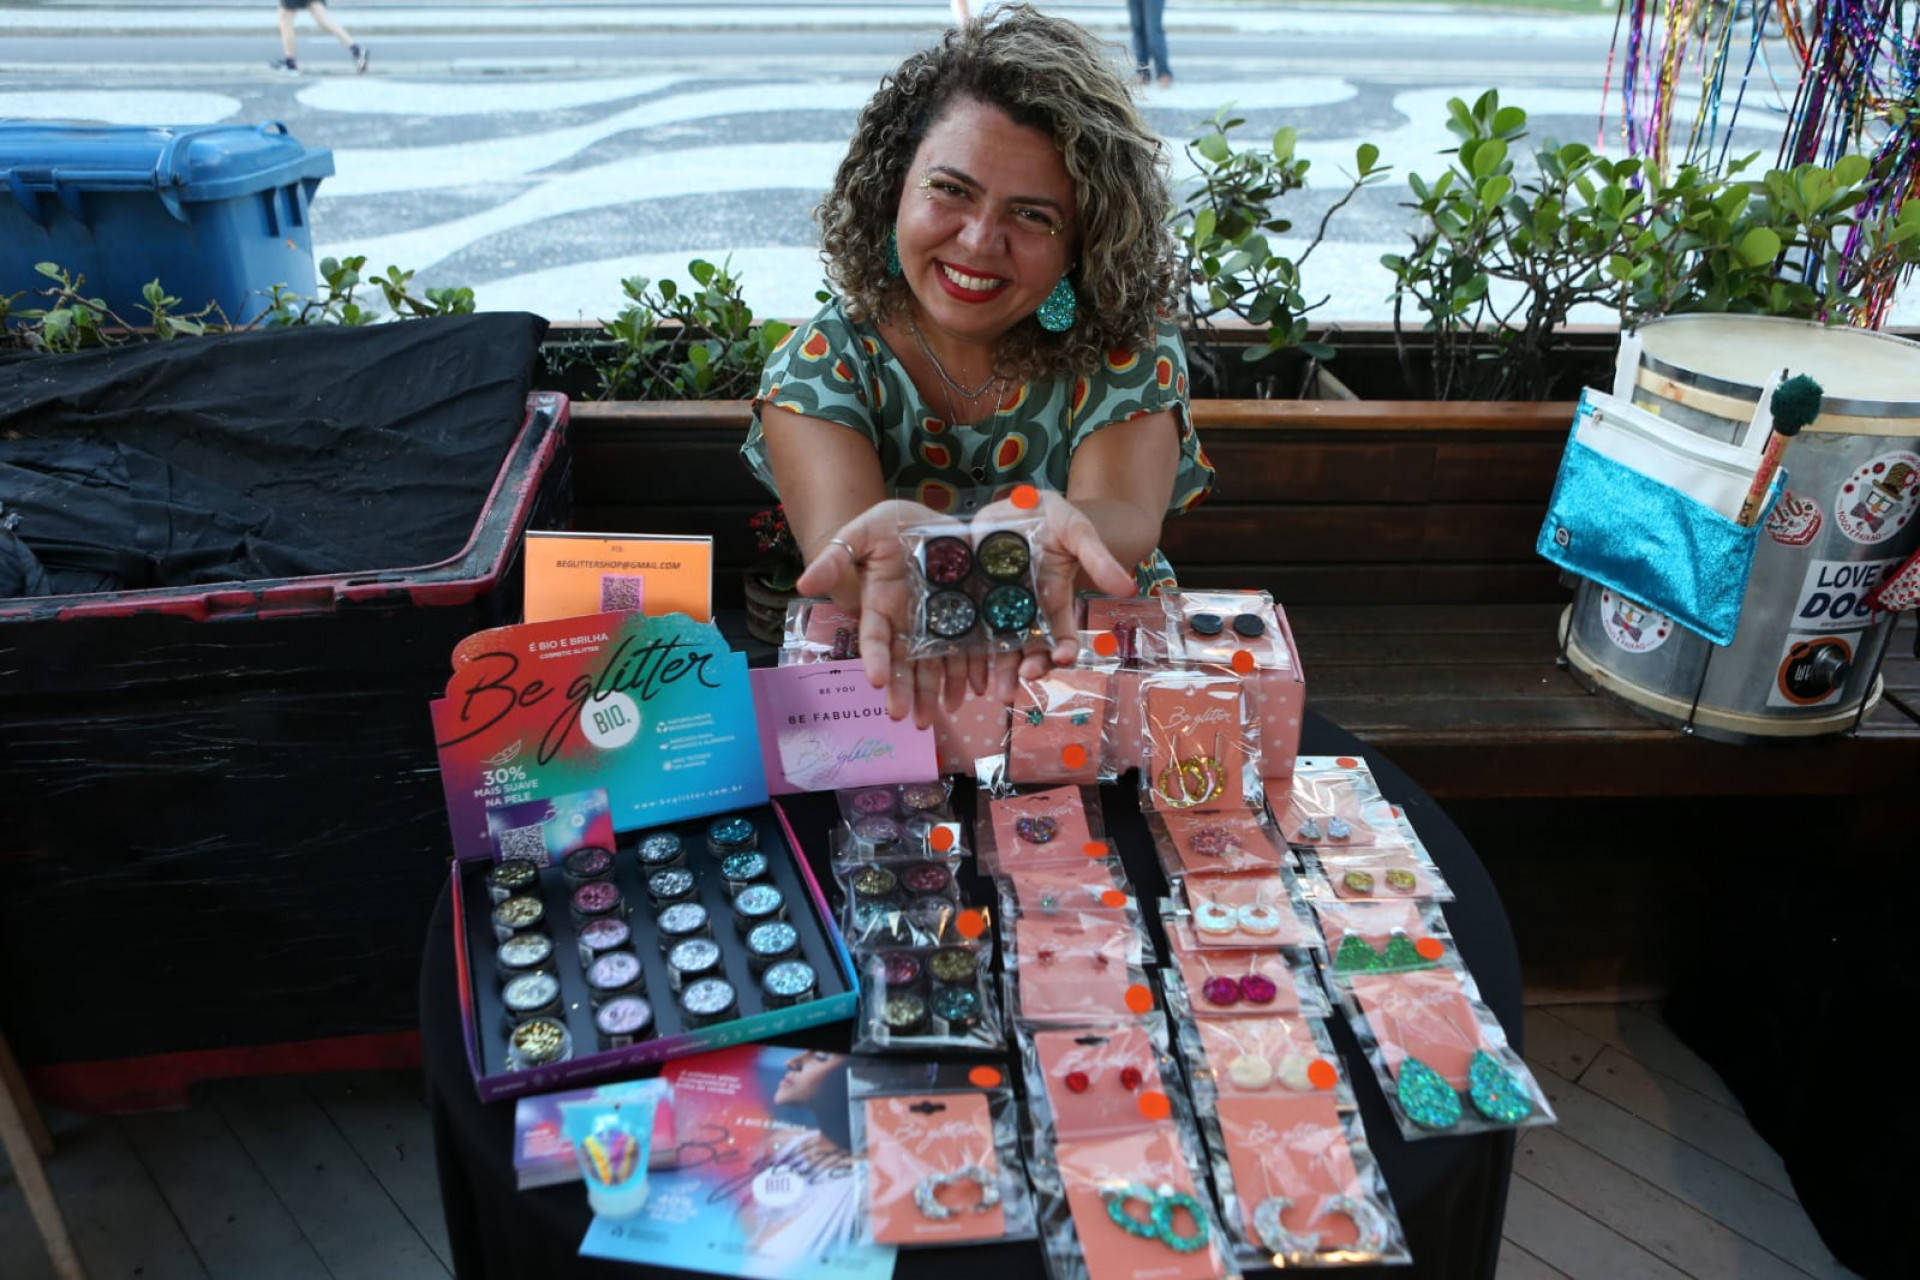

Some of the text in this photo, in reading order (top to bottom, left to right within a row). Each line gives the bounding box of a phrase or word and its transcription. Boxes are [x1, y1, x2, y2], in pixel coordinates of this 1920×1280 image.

[556, 559, 682, 570] BEGLITTERSHOP@GMAIL.COM
[1816, 565, 1882, 588] LOVE
[528, 632, 609, 652] É BIO E BRILHA
[819, 685, 856, 695] BE YOU
[439, 634, 721, 766] Be glitter
[593, 704, 631, 735] BIO.
[788, 714, 806, 725] BE
[482, 765, 527, 786] 30%
[473, 779, 539, 798] MAIS SUAVE
[485, 792, 532, 808] NA PELE
